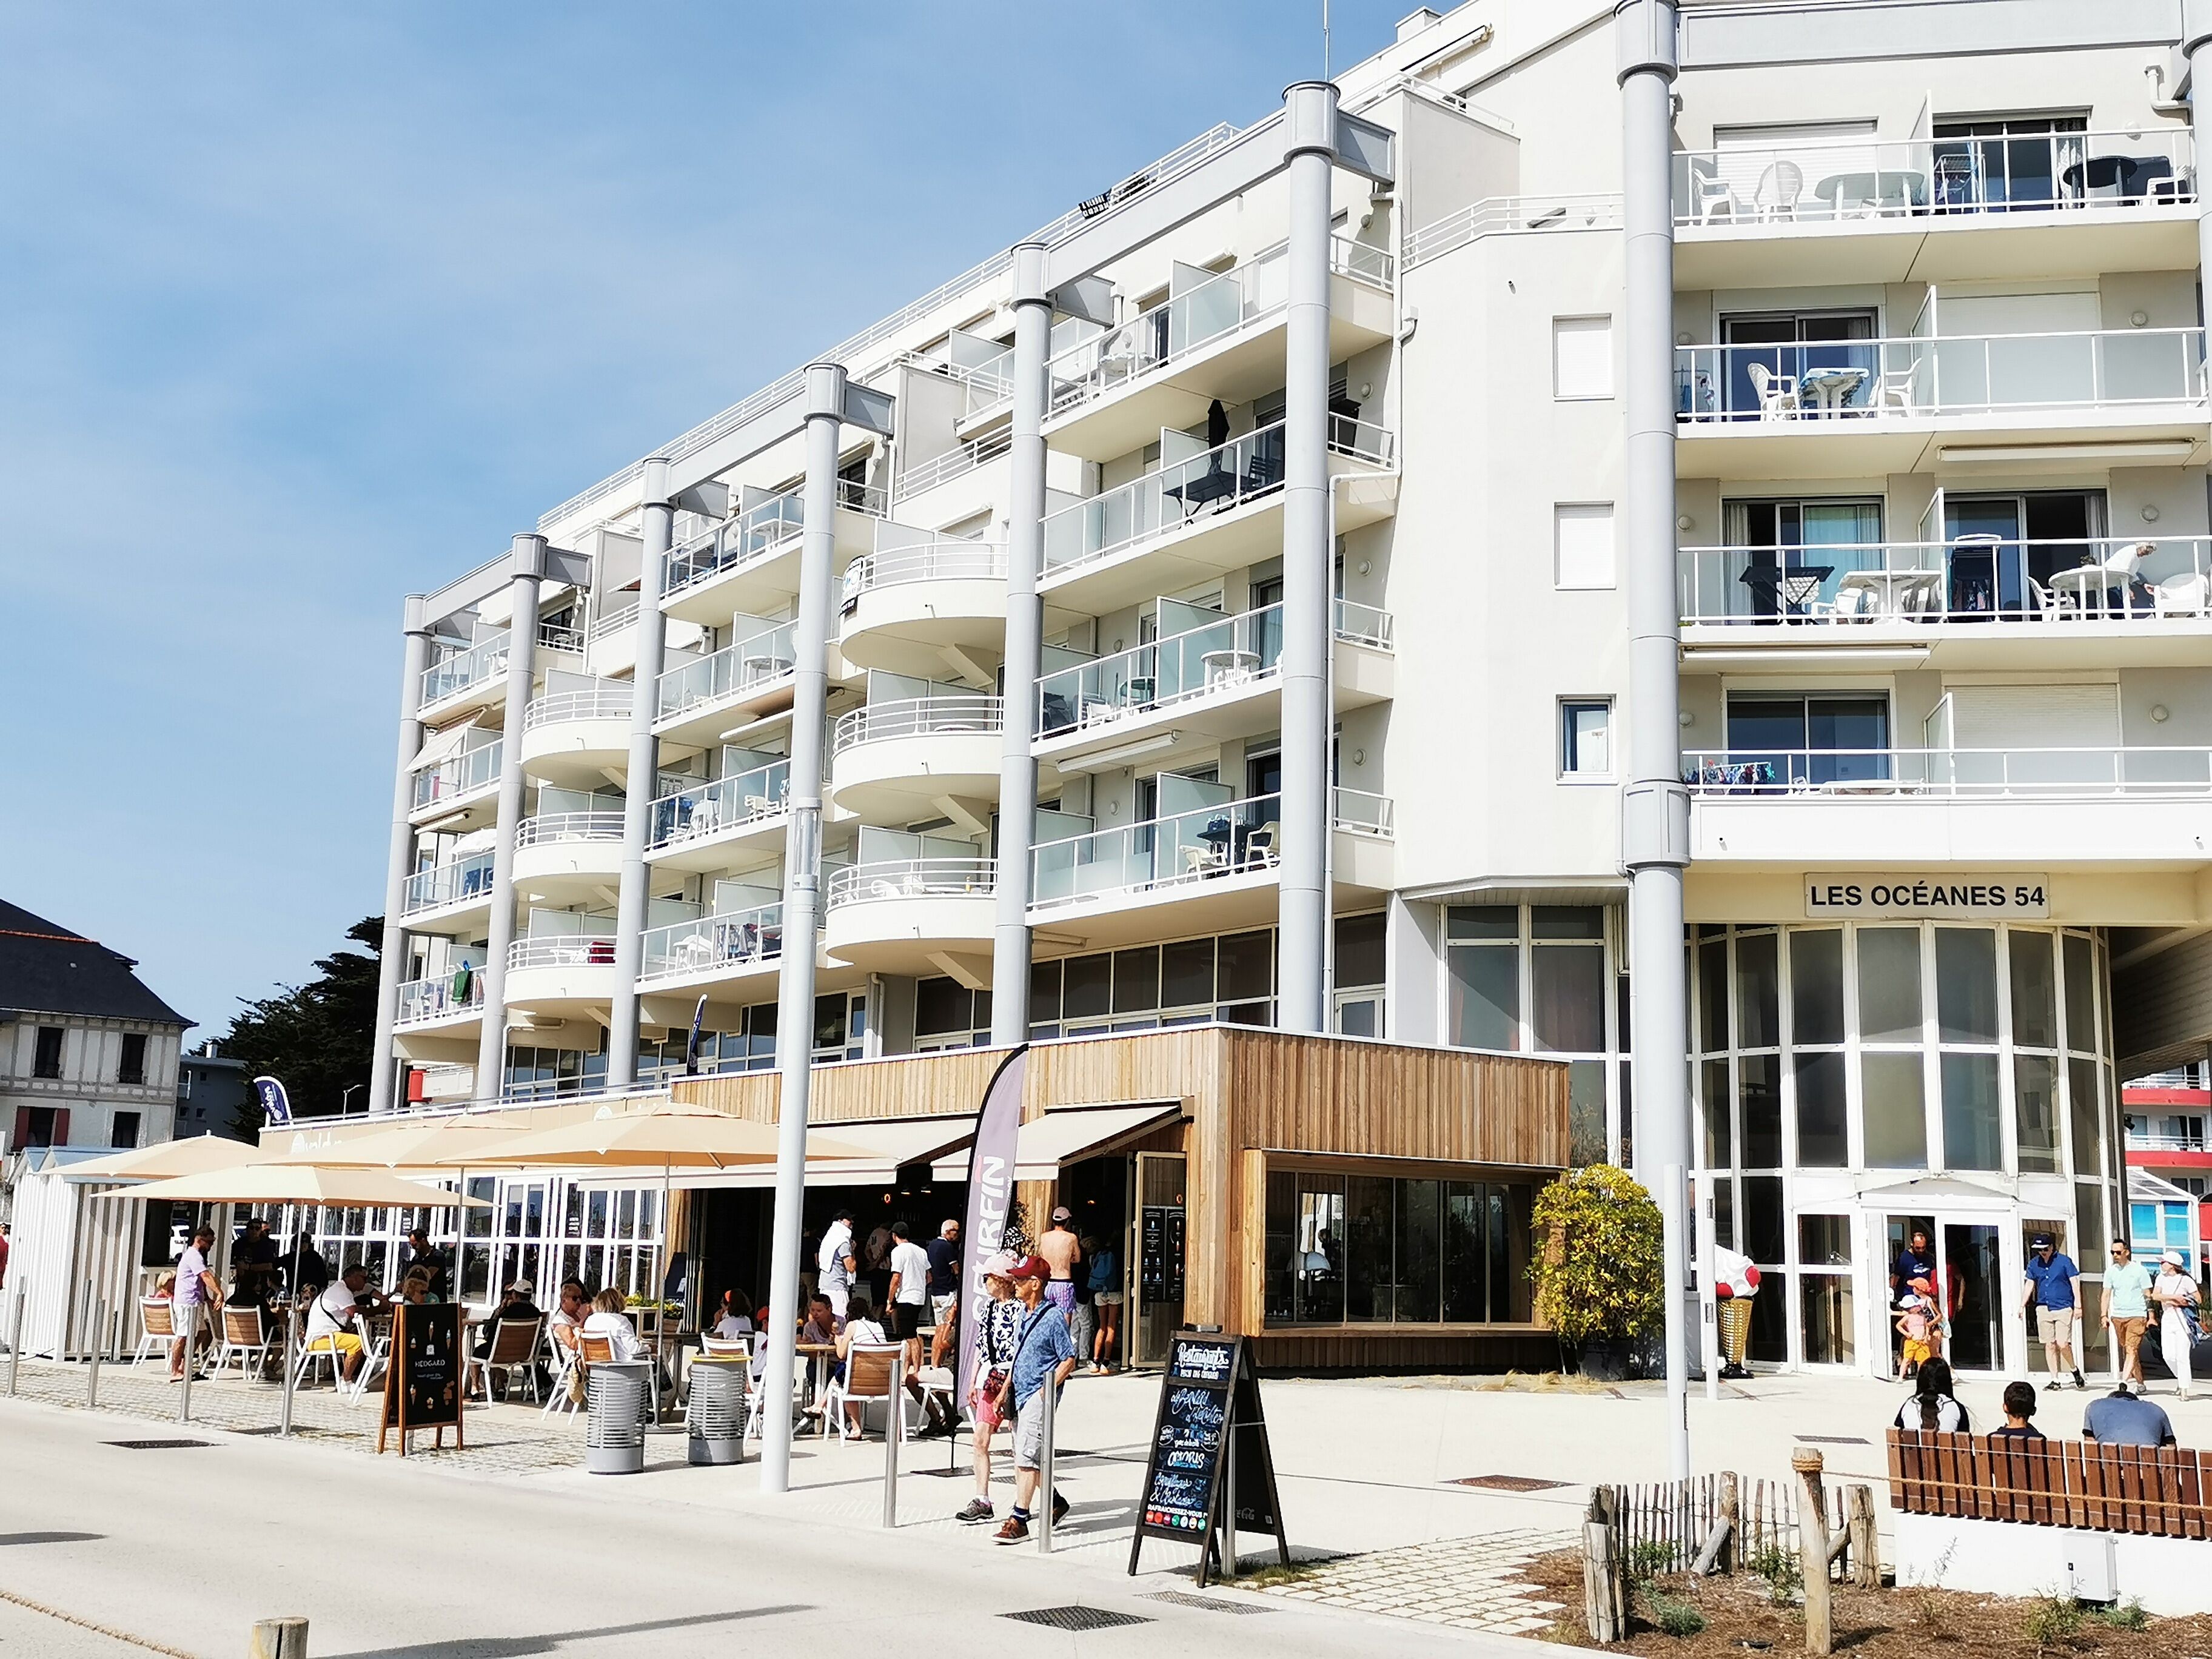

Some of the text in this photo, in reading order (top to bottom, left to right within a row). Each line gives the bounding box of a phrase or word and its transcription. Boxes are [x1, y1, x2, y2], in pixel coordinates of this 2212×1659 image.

[1811, 880, 2045, 906] LES OCÉANES 54
